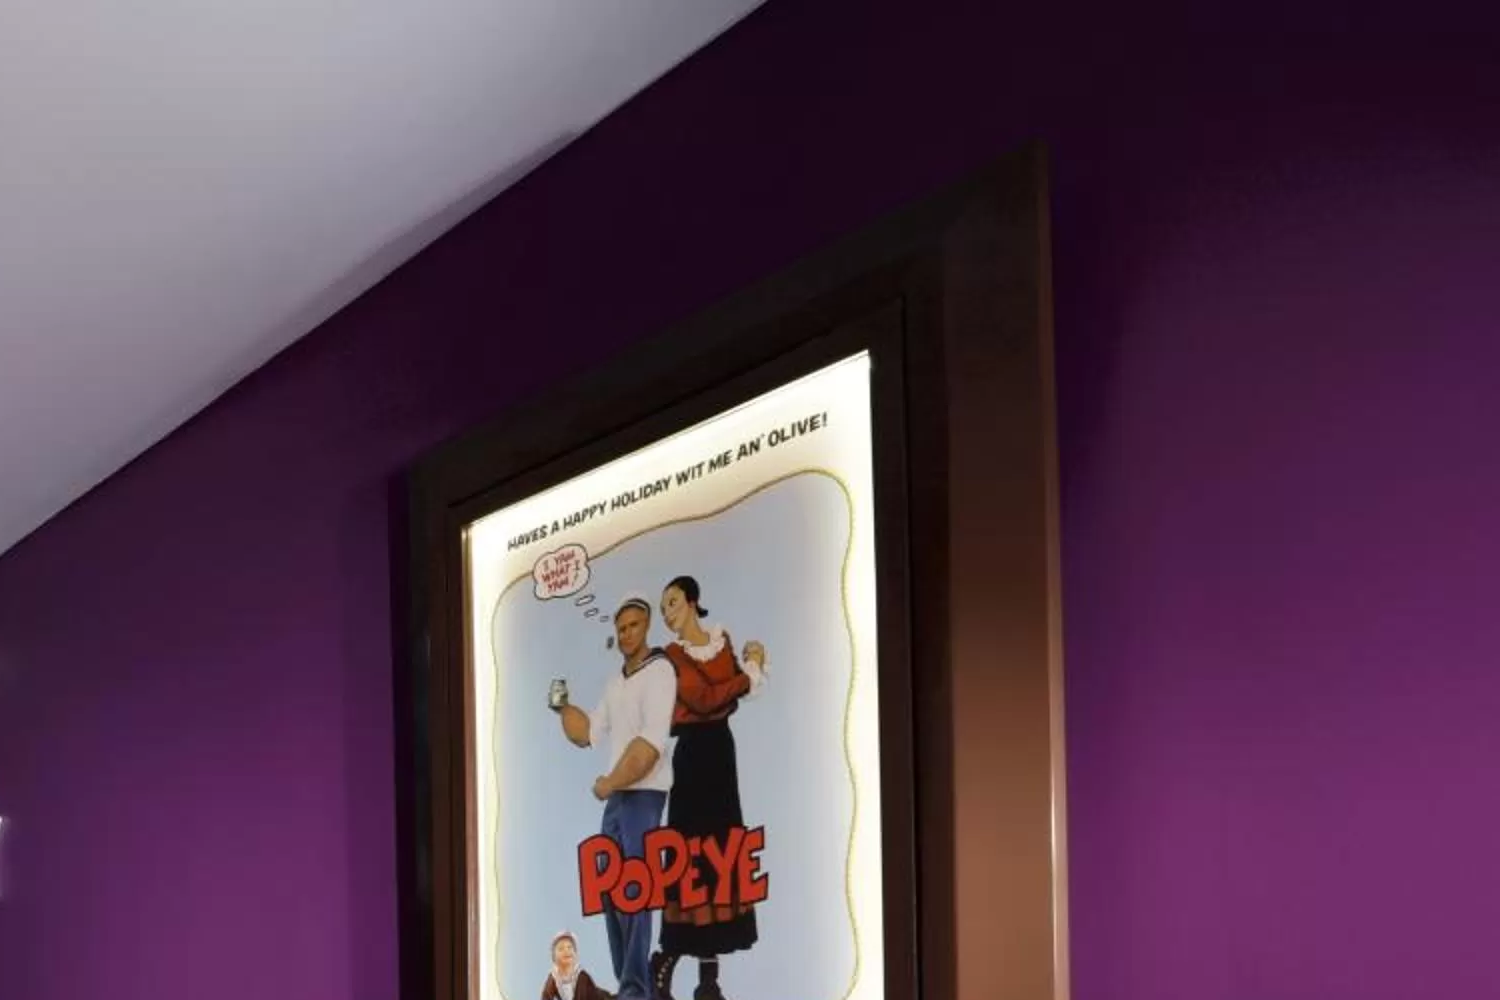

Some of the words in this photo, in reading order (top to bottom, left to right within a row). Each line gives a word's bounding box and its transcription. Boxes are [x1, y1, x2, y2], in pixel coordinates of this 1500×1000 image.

[507, 524, 548, 551] HAVES
[550, 519, 561, 535] A
[563, 499, 608, 531] HAPPY
[611, 476, 672, 512] HOLIDAY
[675, 461, 706, 487] WIT
[708, 449, 733, 473] ME
[767, 411, 828, 448] OLIVE!
